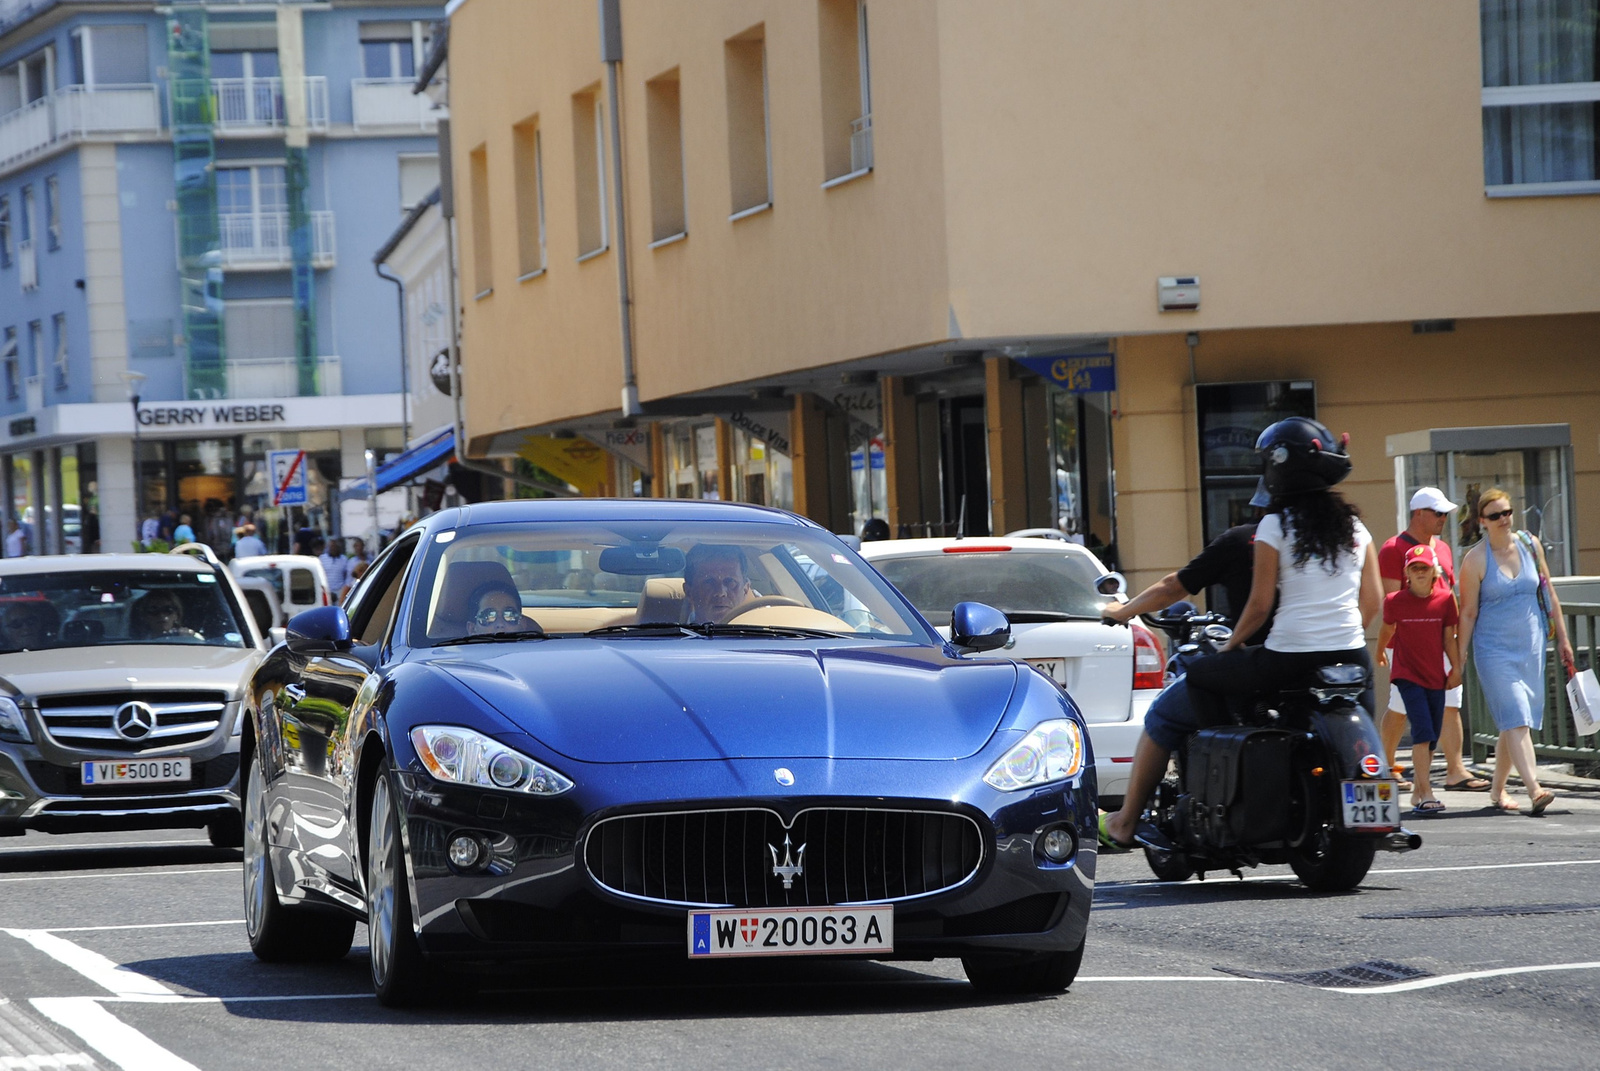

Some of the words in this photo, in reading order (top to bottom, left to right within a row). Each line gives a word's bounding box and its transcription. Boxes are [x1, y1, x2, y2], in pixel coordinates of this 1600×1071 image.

[137, 407, 207, 425] GERRY
[212, 404, 285, 422] WEBER
[99, 764, 114, 780] VI
[128, 762, 158, 779] 500
[163, 761, 182, 777] BC
[1351, 804, 1377, 823] 213
[1381, 804, 1392, 823] K
[716, 918, 737, 948] W
[762, 915, 857, 946] 20063
[863, 914, 883, 944] A
[698, 939, 706, 949] A
